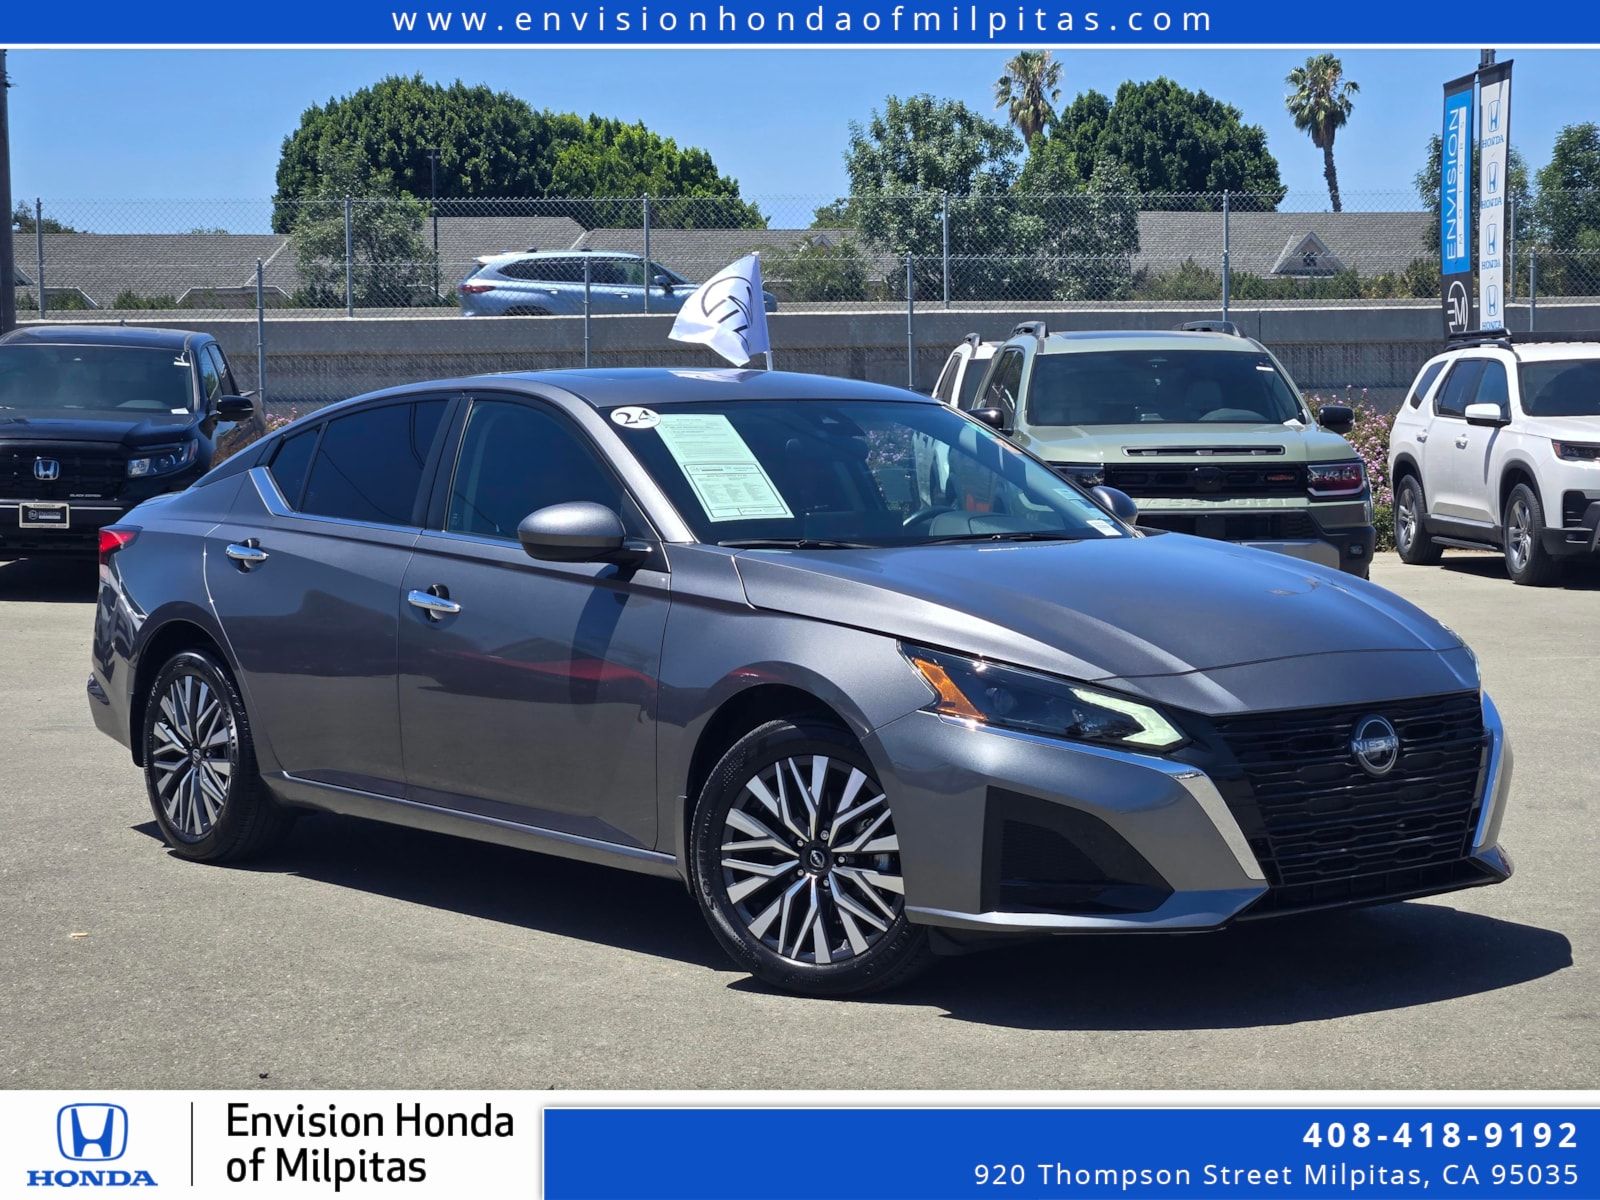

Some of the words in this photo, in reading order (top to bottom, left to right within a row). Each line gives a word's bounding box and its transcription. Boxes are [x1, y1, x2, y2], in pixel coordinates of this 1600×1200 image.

[1480, 135, 1504, 148] HONDA
[1446, 108, 1459, 259] ENVISION
[1480, 197, 1502, 209] HONDA
[1481, 259, 1501, 270] HONDA
[1481, 321, 1502, 331] HONDA
[1353, 737, 1398, 751] NISSAN
